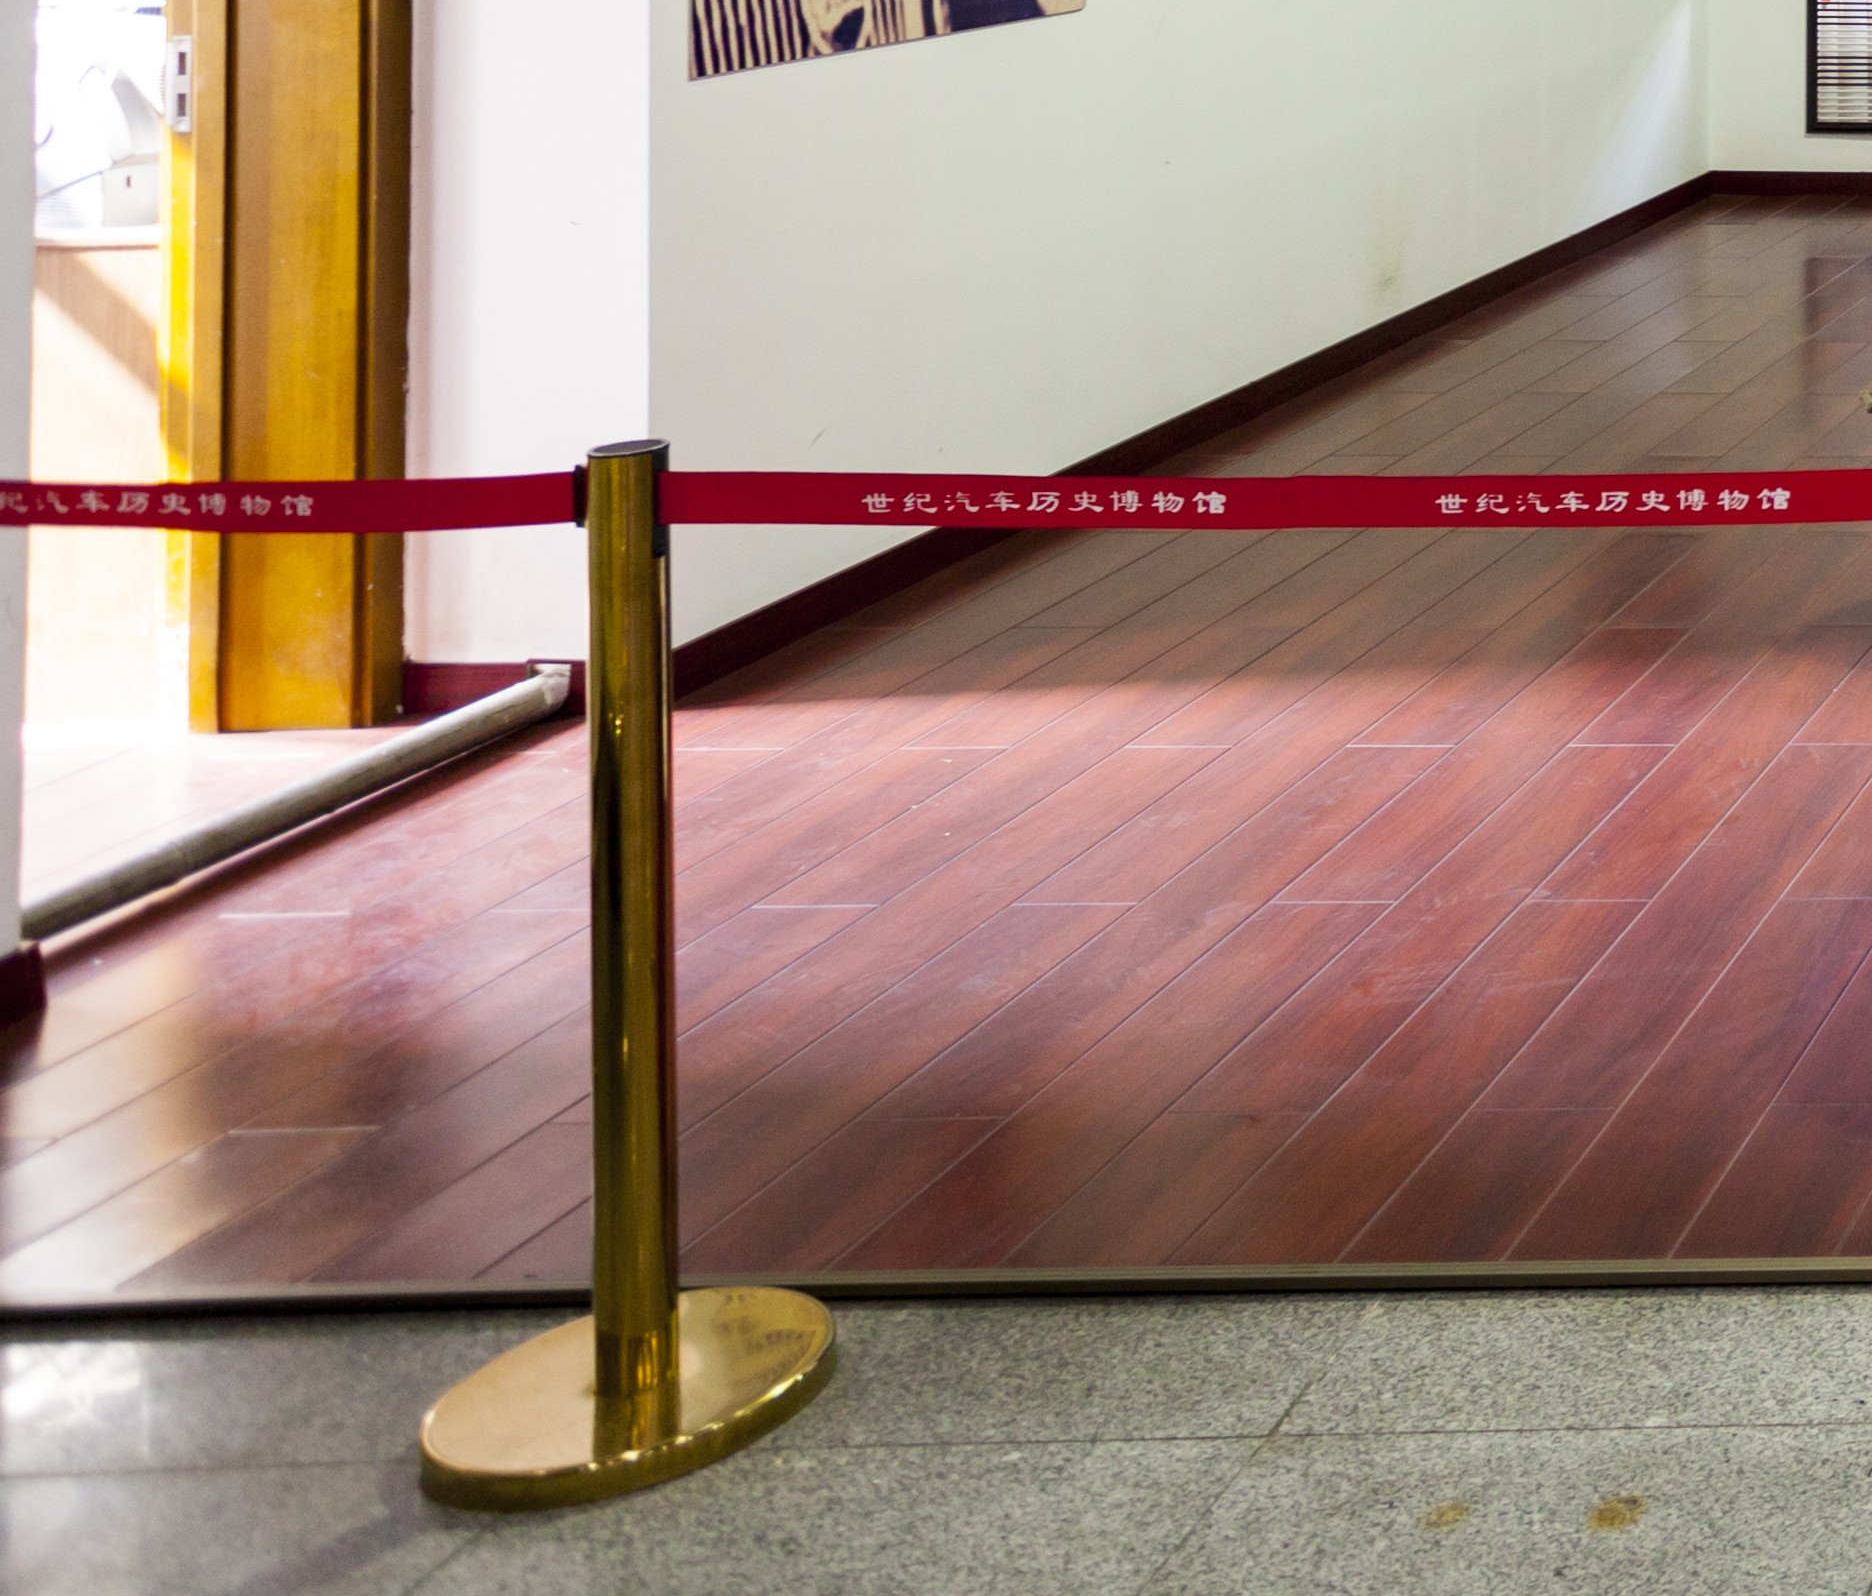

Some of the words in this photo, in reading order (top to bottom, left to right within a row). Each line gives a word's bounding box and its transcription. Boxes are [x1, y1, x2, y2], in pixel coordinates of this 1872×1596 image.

[861, 490, 1227, 515] 世纪汽车历史博物馆
[1434, 488, 1791, 515] 世纪汽车历史博物馆
